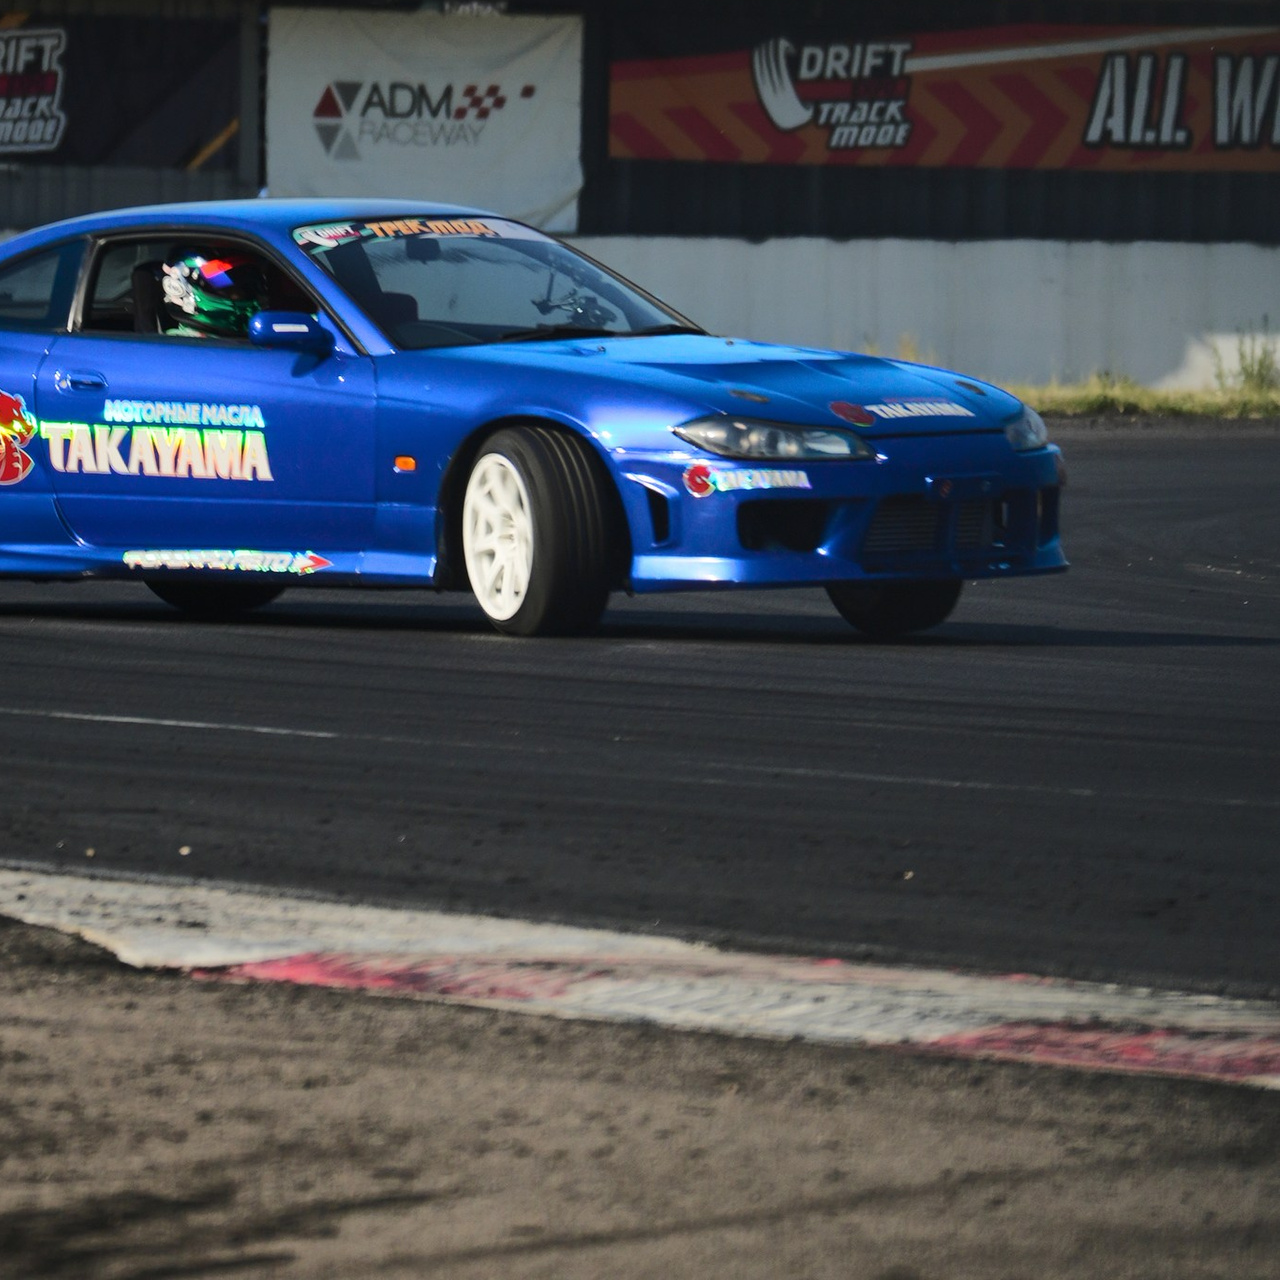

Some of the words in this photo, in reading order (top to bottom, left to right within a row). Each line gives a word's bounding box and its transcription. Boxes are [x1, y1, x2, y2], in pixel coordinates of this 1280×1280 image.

[798, 42, 912, 80] DRIFT
[360, 81, 454, 119] ADM
[818, 100, 905, 126] TRACK
[1083, 54, 1187, 144] ALL
[1216, 55, 1280, 144] W
[358, 120, 488, 147] RACEWAY
[830, 123, 912, 149] MODE
[103, 398, 201, 425] МОТОРНЫЕ
[202, 402, 265, 428] МАСЛА
[863, 402, 977, 419] TAKAYAMA
[40, 421, 275, 482] TAKAYAMA
